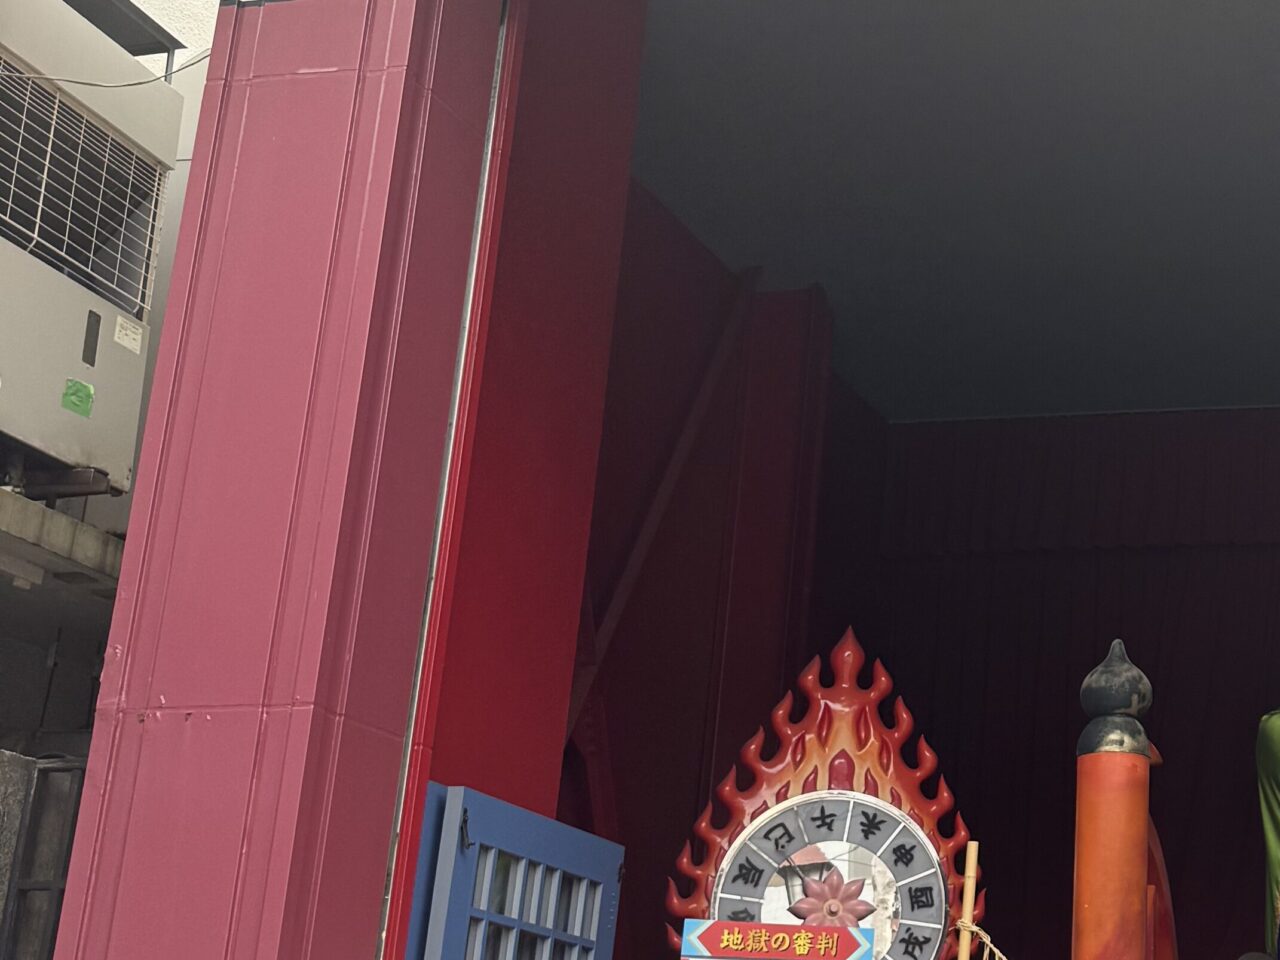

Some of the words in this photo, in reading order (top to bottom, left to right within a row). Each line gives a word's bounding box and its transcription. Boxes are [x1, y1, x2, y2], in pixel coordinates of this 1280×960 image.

[810, 805, 837, 832] 午
[861, 810, 887, 840] 未
[892, 843, 917, 868] 申
[731, 856, 764, 888] 辰
[908, 886, 935, 912] 酉
[720, 927, 840, 957] 地獄の審判
